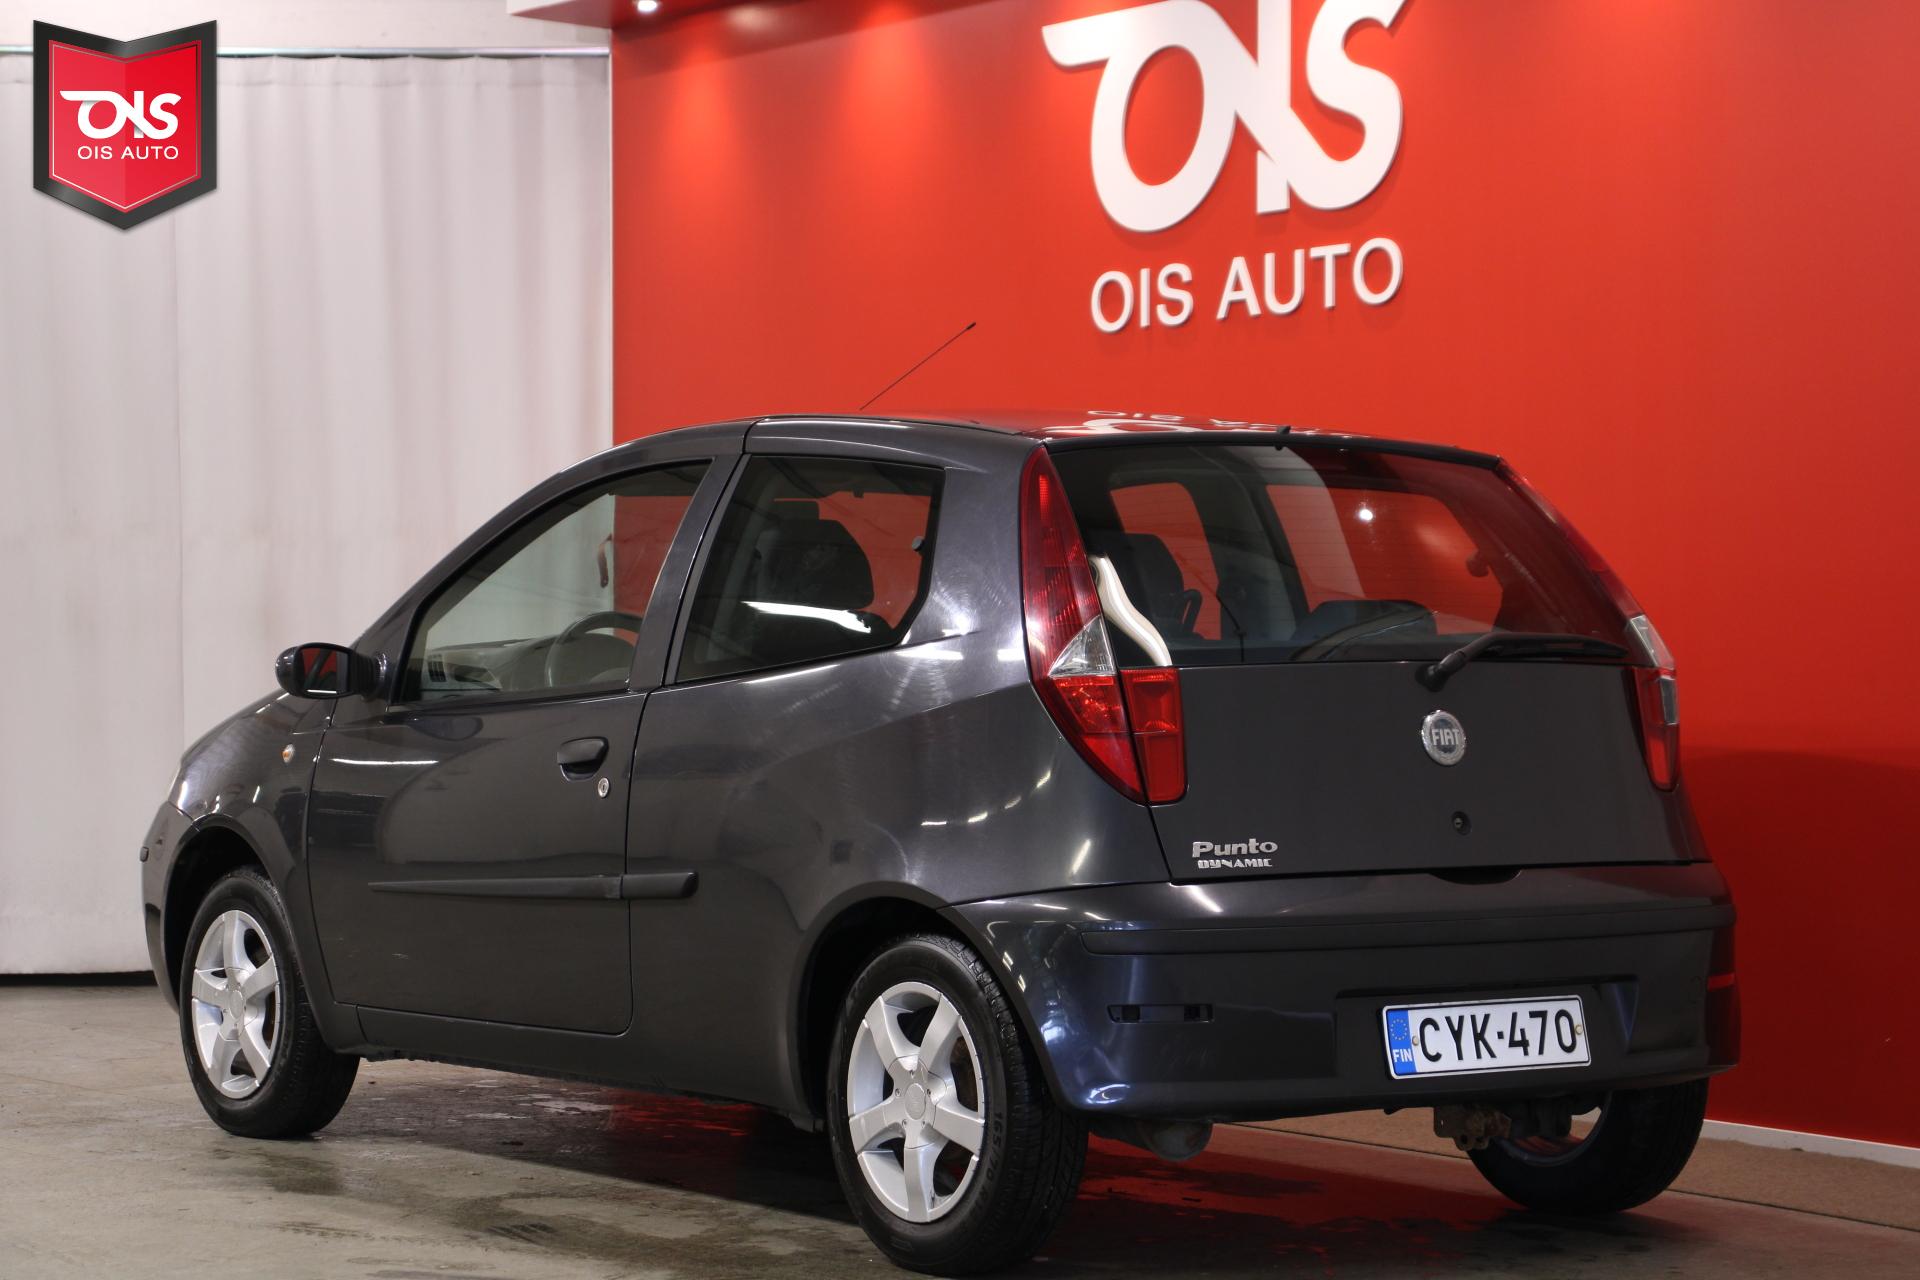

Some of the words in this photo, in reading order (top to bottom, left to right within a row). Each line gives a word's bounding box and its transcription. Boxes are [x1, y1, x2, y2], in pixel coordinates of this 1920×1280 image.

[1042, 0, 1403, 233] OIS
[1091, 263, 1194, 333] OIS
[1216, 238, 1402, 320] AUTO
[1432, 728, 1460, 746] FIAT
[1192, 838, 1278, 858] Punto
[1197, 858, 1273, 869] DYNAMIC
[1419, 1009, 1577, 1062] CYK-470
[1392, 1048, 1413, 1063] FIN
